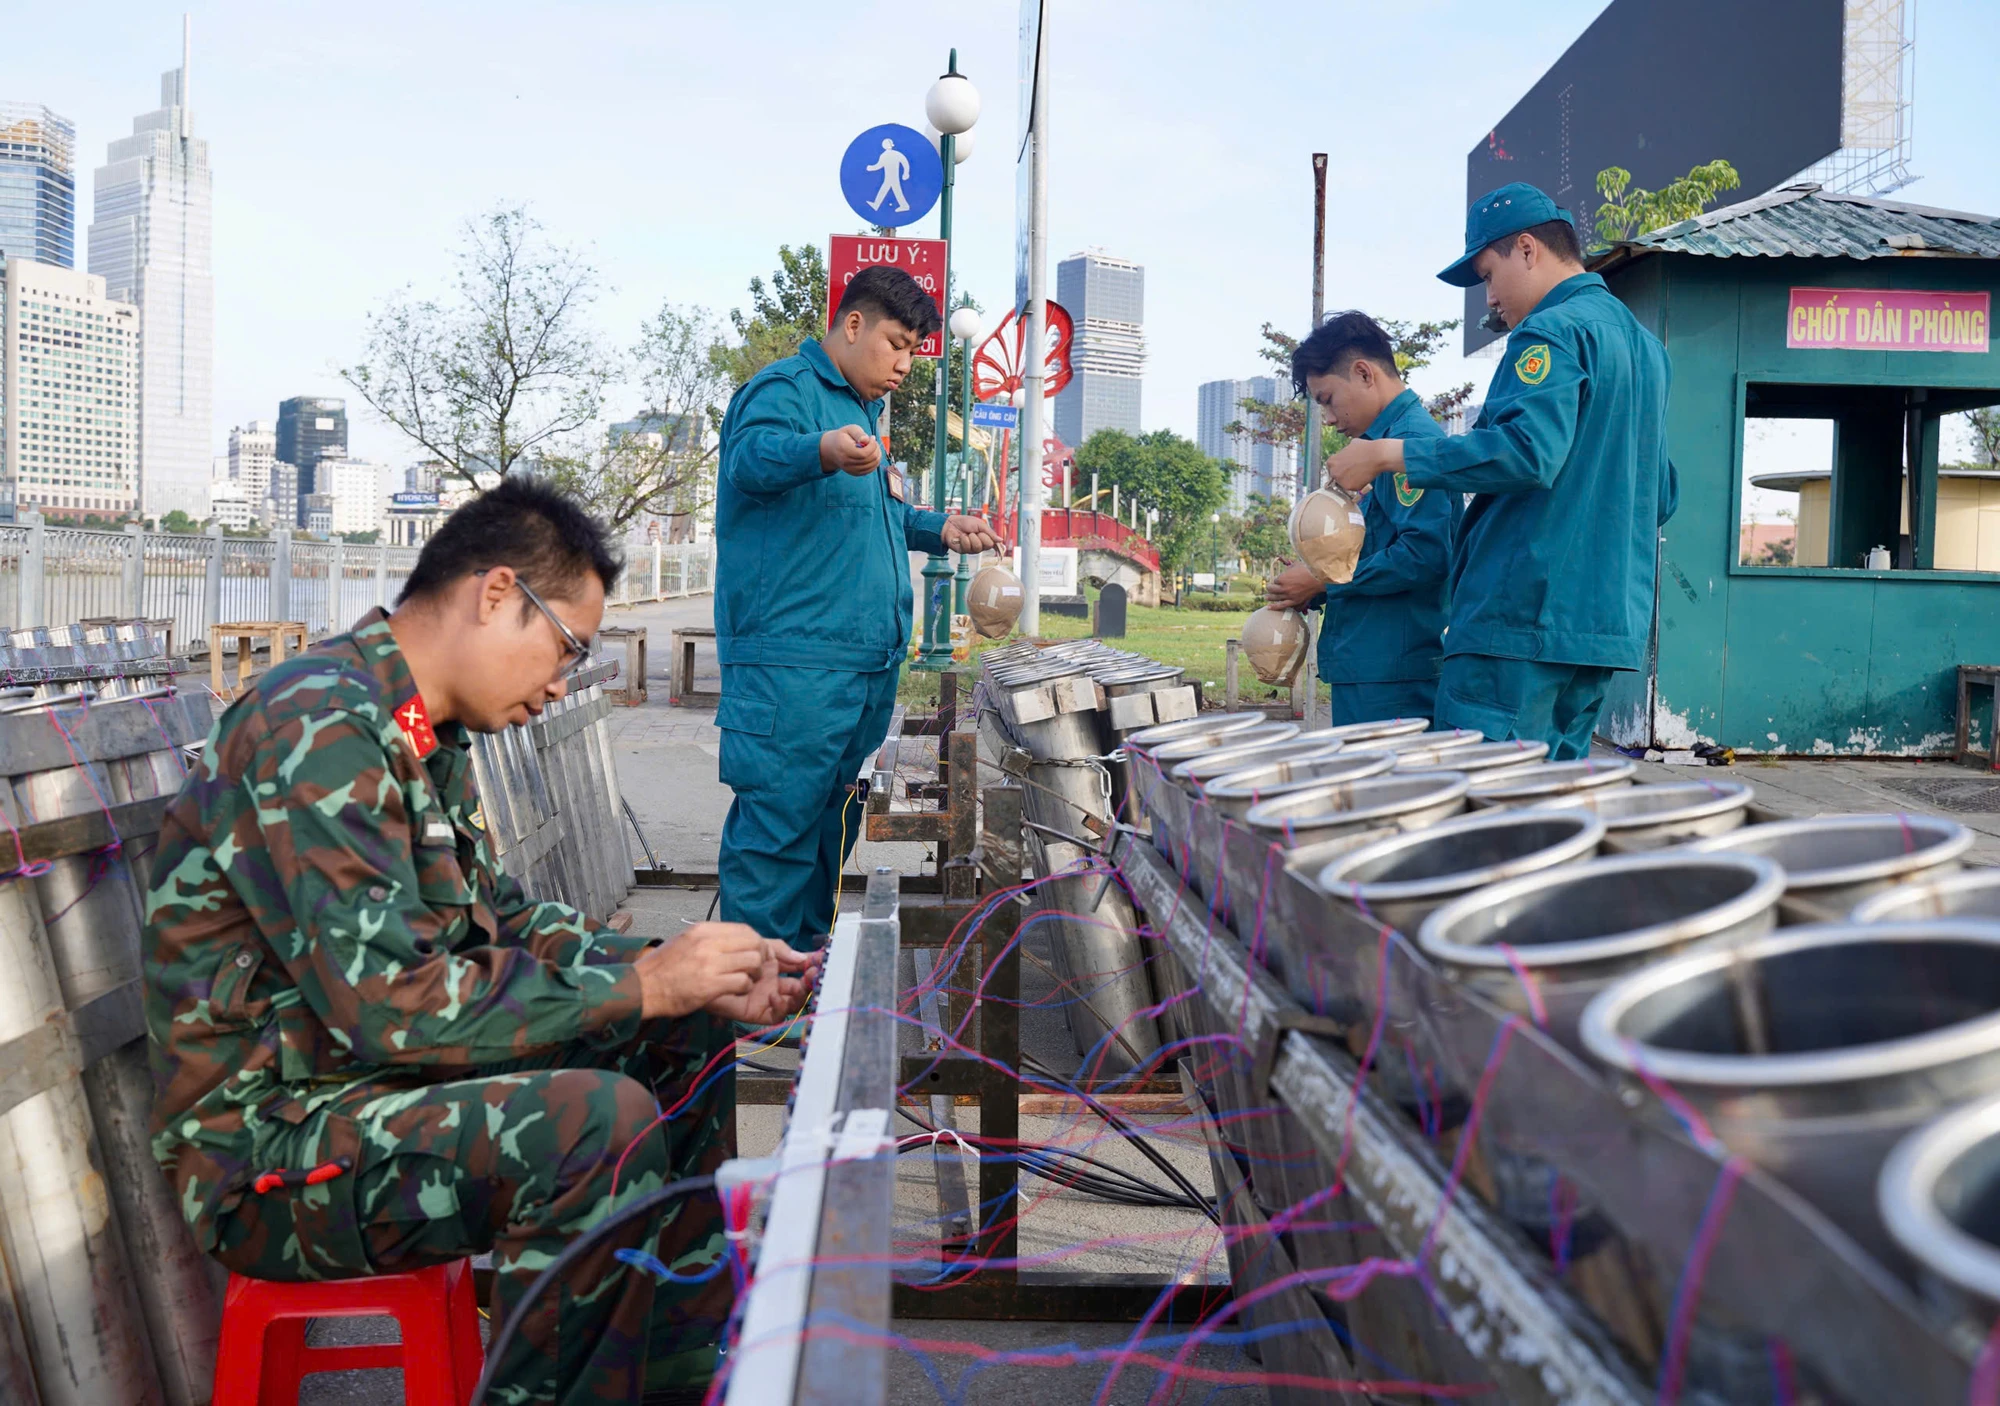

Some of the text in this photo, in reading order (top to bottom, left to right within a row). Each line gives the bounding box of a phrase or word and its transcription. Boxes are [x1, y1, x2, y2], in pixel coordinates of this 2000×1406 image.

[857, 242, 928, 265] LƯU Ý:
[87, 279, 97, 296] R
[1792, 294, 1985, 345] CHỐT DÂN PHÒNG
[396, 494, 436, 502] HYOSUNG
